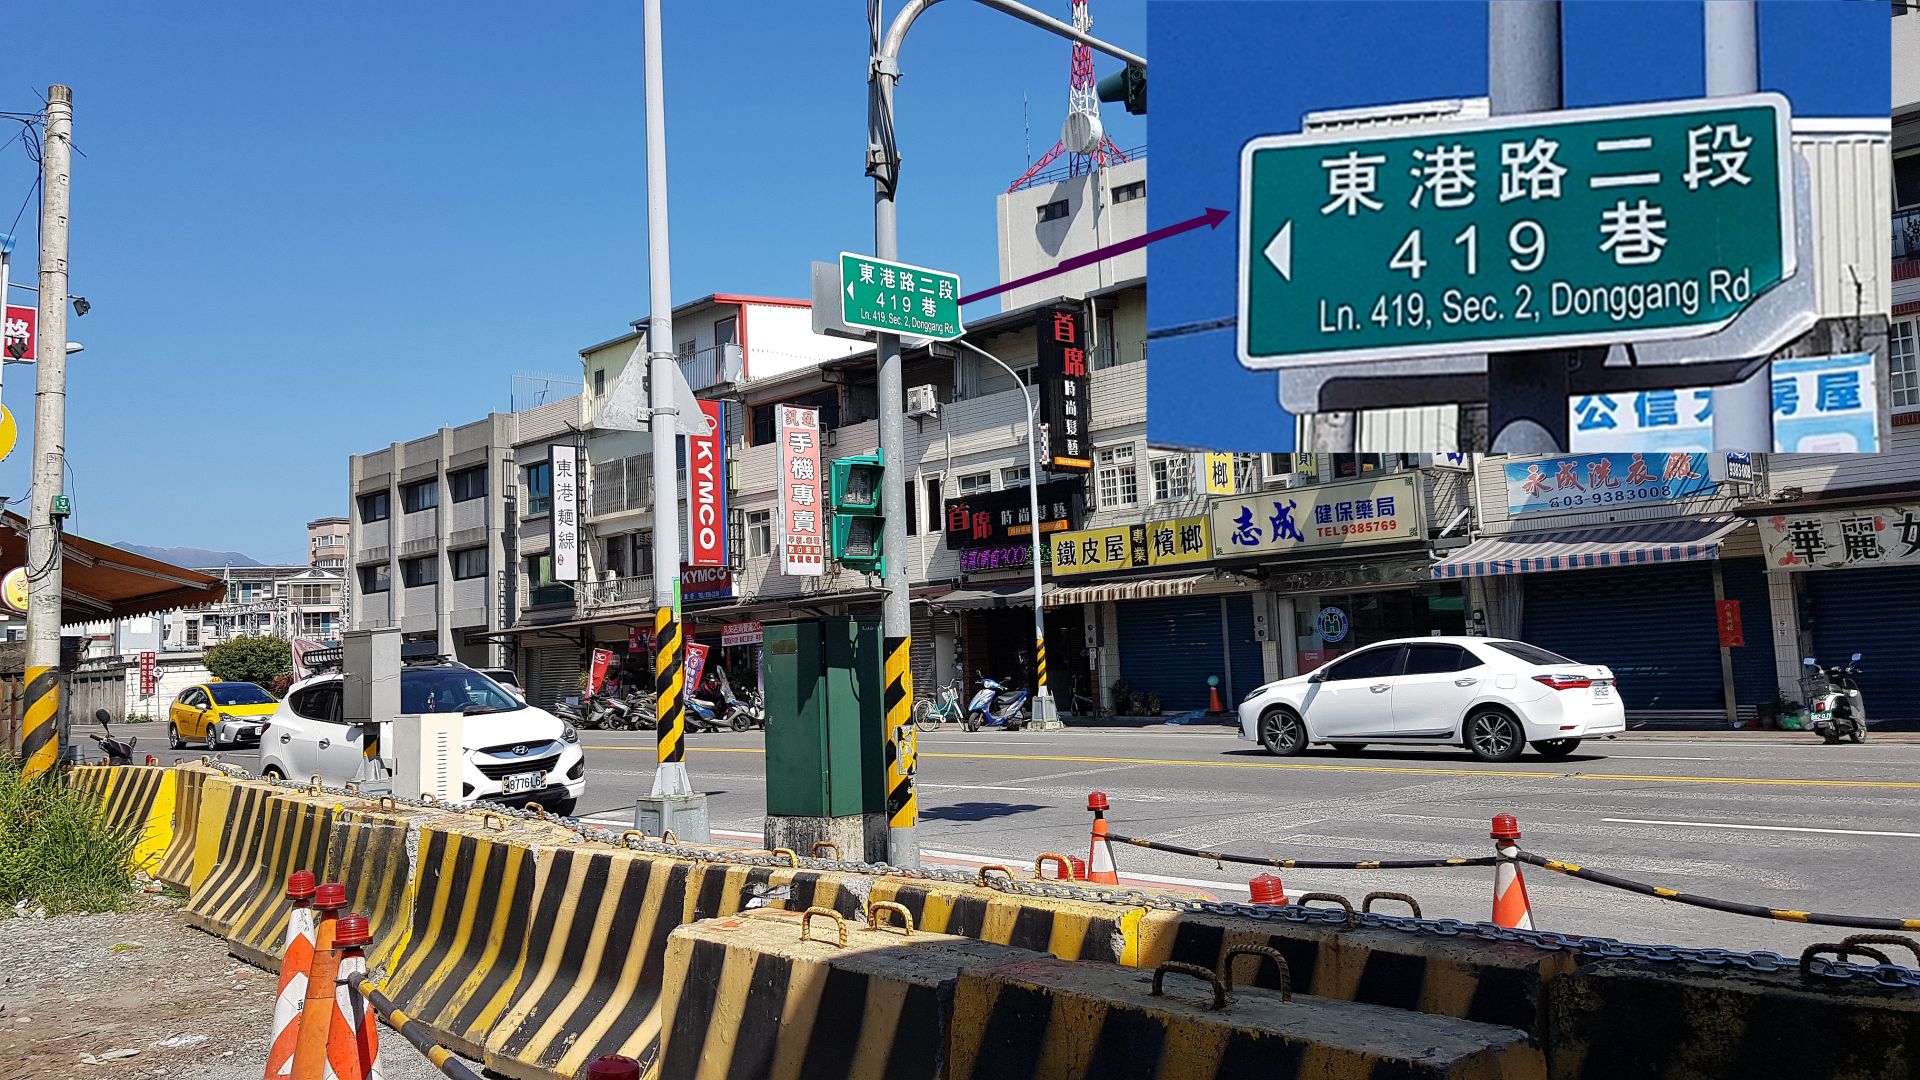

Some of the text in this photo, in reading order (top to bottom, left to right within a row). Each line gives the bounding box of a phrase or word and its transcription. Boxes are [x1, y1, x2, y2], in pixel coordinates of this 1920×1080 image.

[1320, 124, 1753, 216] 東港路二段
[858, 262, 954, 301] 東港路二段
[860, 308, 872, 320] Ln.
[888, 313, 903, 326] Sec.
[911, 317, 943, 335] Donggang
[944, 322, 956, 334] Rd.
[1320, 298, 1361, 332] Ln.
[1371, 292, 1432, 330] 419,
[1442, 289, 1504, 324] Sec.
[1514, 284, 1540, 323] 2,
[1551, 280, 1699, 321] Donggang
[1052, 311, 1085, 378] 首席
[788, 431, 816, 533] 手機專賣
[1211, 453, 1228, 488] 榔
[556, 458, 575, 551] 東港麵線
[697, 440, 716, 550] KYMCO
[1563, 485, 1672, 507] 03-9383008
[948, 502, 993, 540] 首席
[1231, 496, 1396, 546] 志成 健保藥局
[1056, 535, 1126, 567] 鐵皮屋
[1132, 528, 1147, 563] 專業
[1153, 524, 1204, 558] 檳榔
[681, 567, 727, 585] KYMCO
